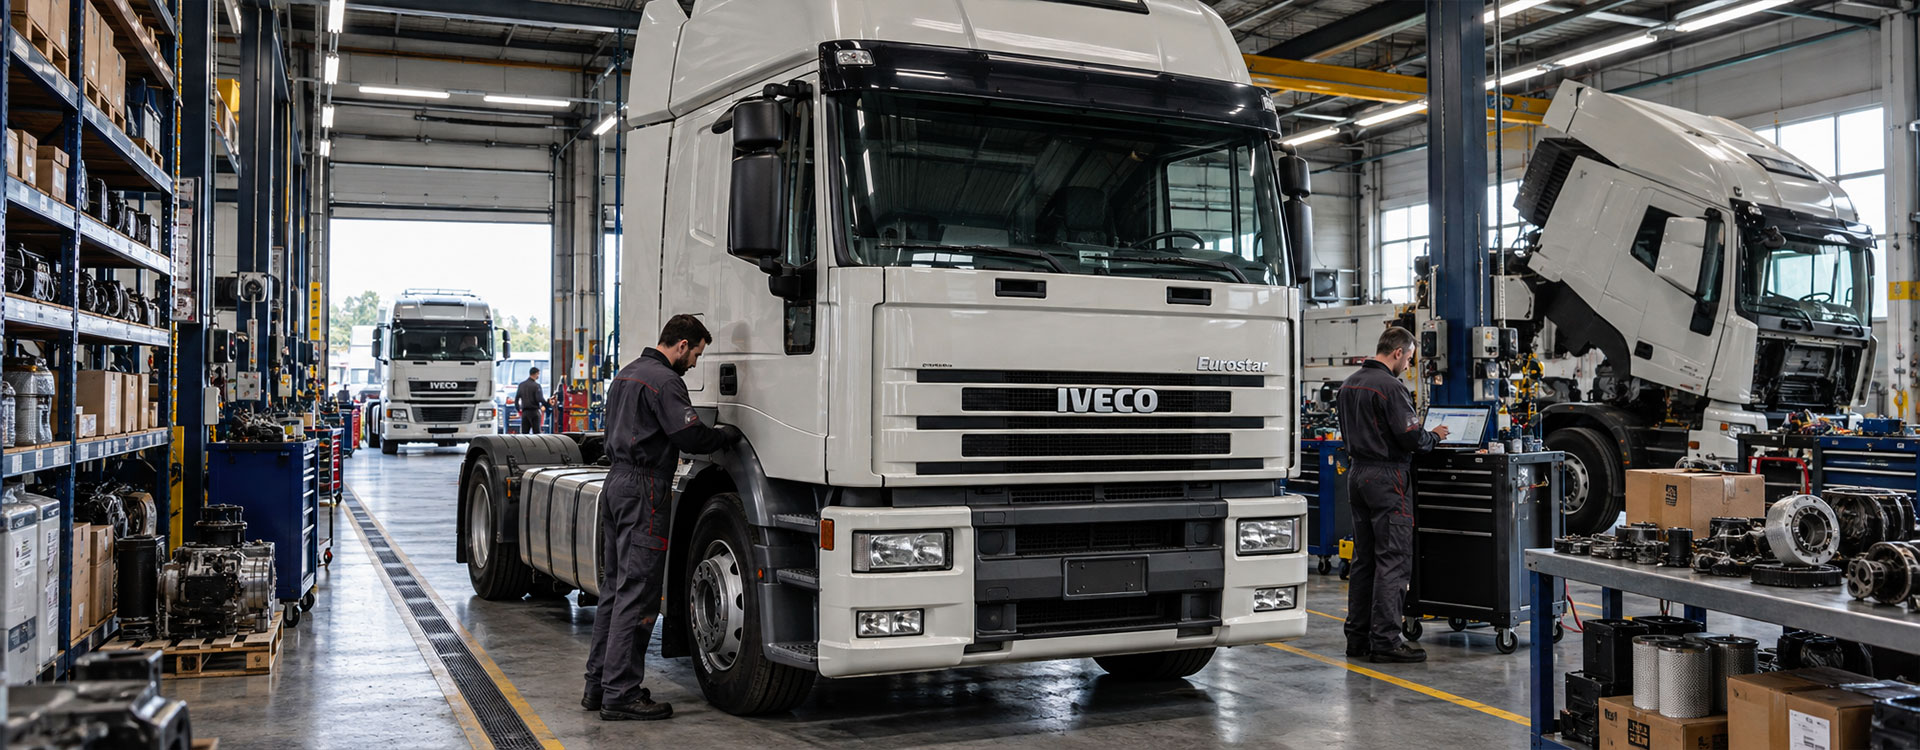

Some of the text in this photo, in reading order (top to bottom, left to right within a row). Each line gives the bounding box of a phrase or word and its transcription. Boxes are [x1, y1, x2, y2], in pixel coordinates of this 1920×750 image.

[1197, 356, 1268, 372] Eurostar
[430, 381, 458, 389] IVECO
[1056, 387, 1159, 413] IVECO
